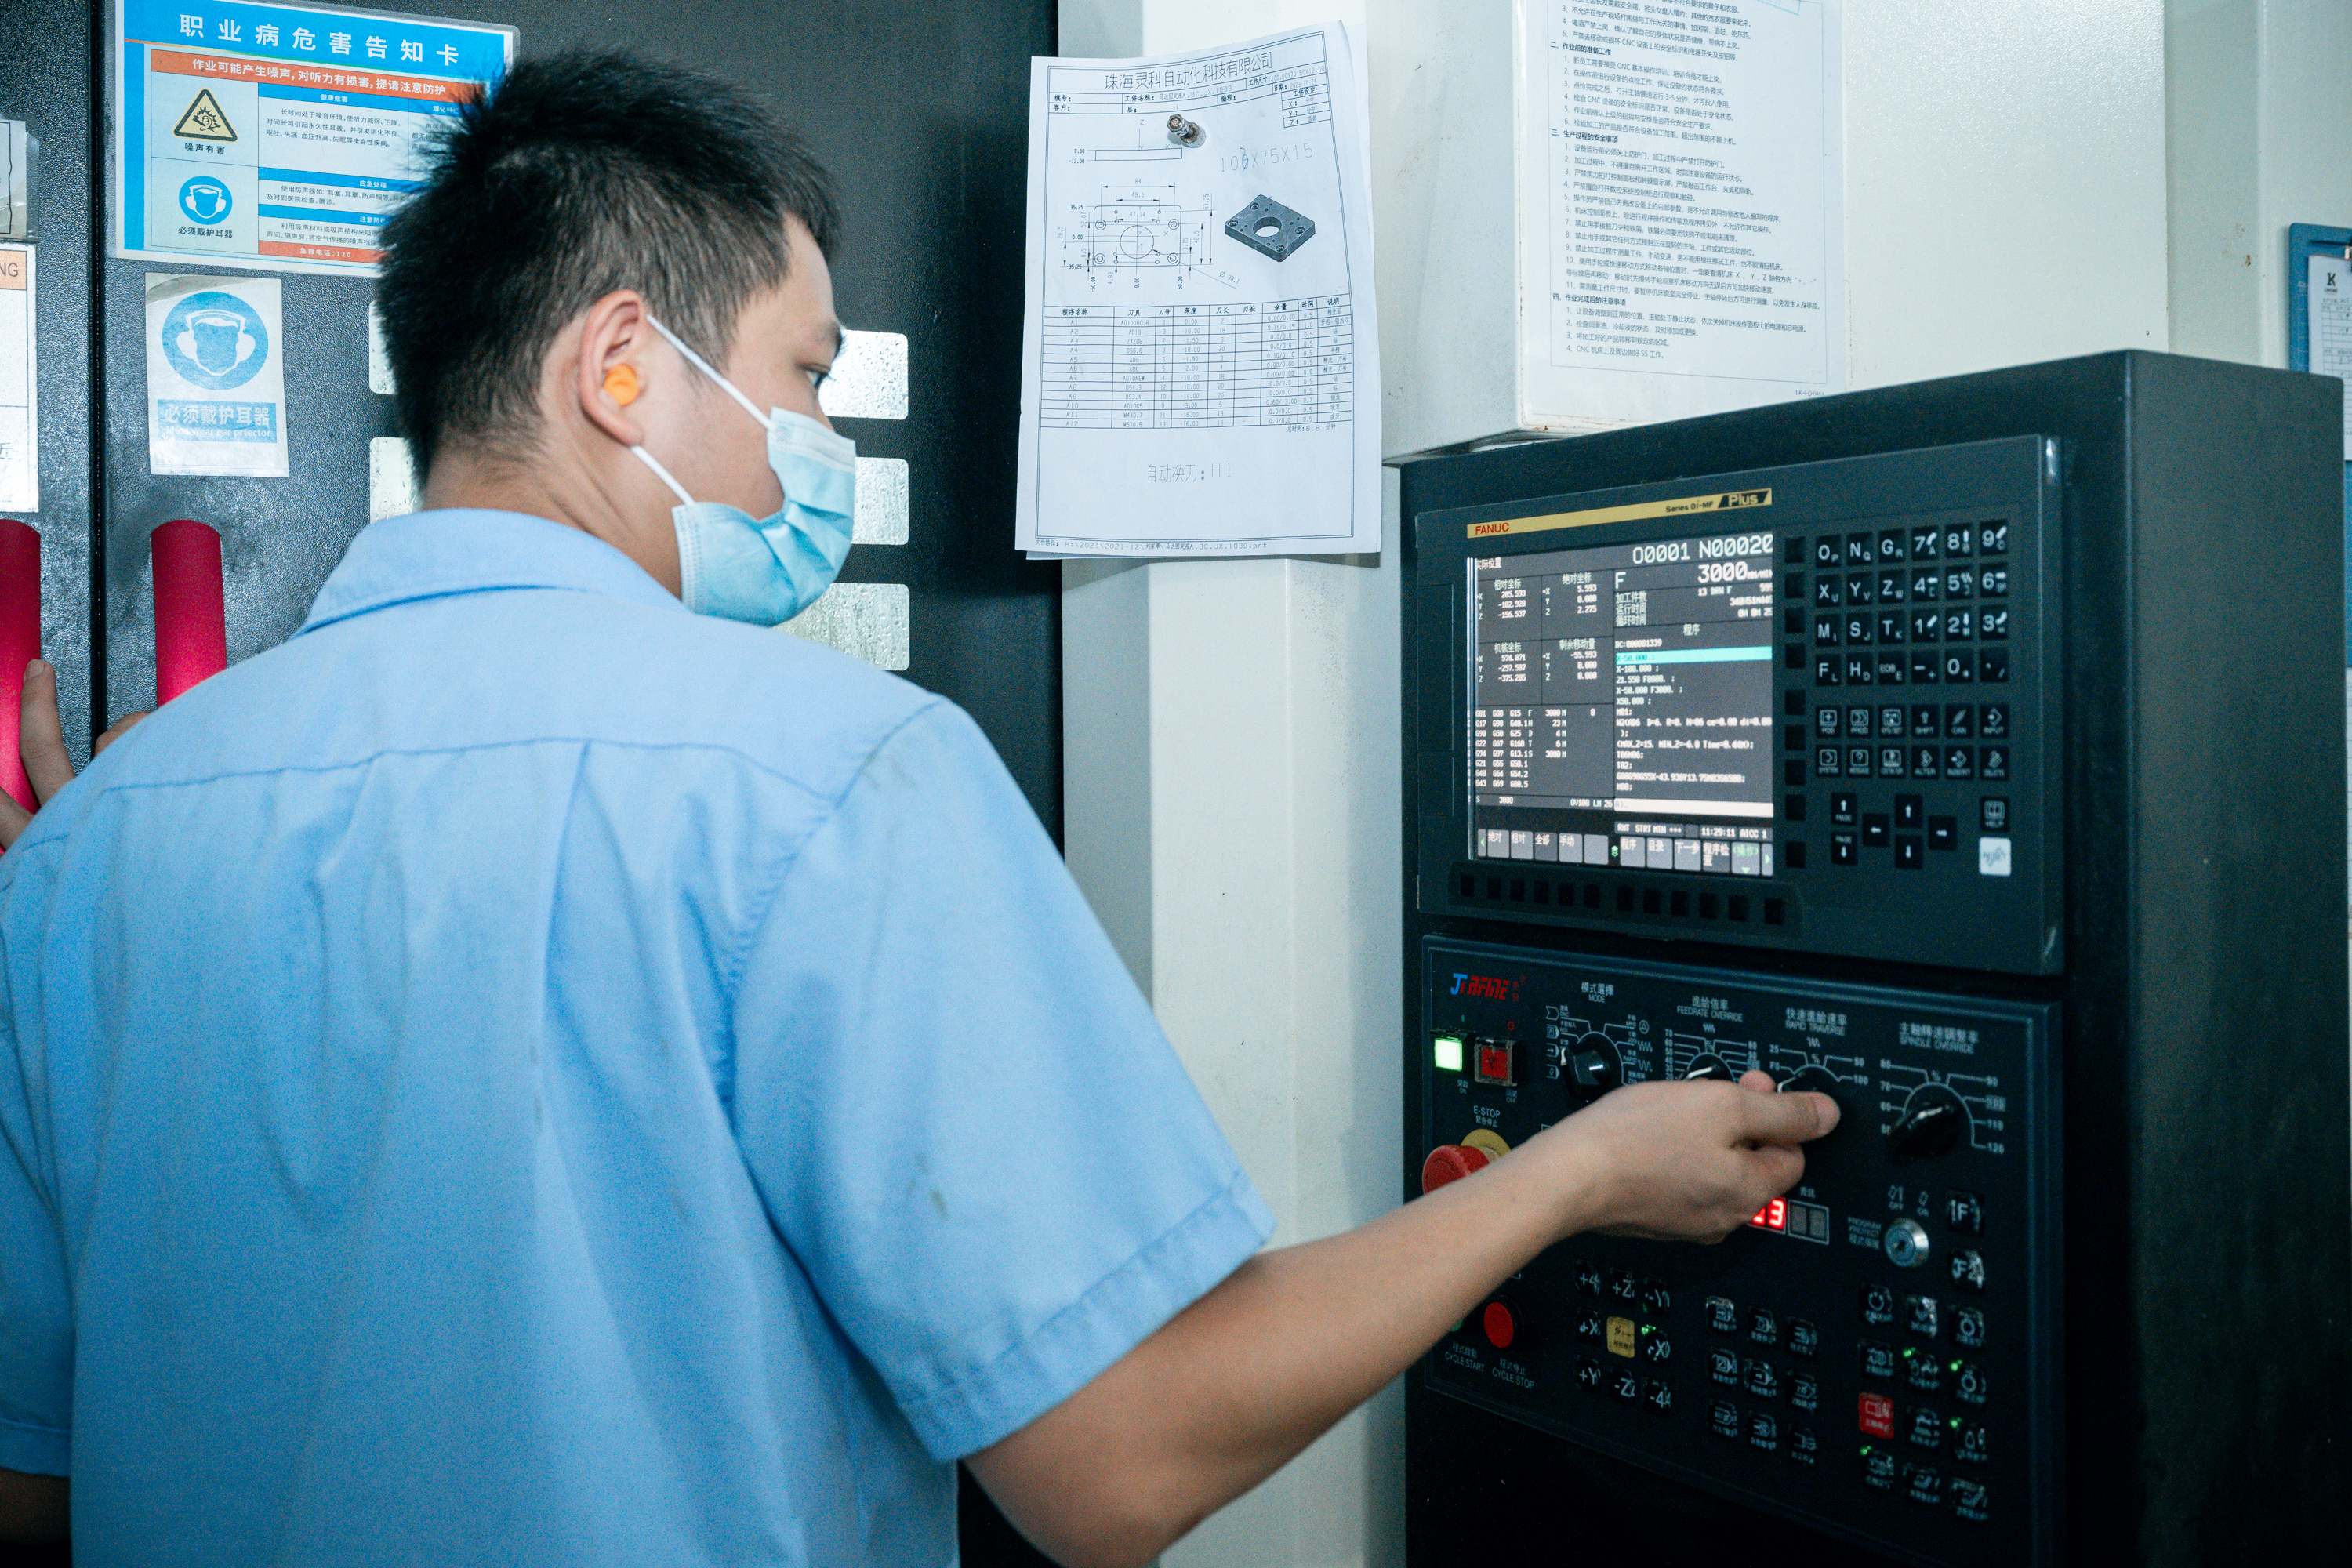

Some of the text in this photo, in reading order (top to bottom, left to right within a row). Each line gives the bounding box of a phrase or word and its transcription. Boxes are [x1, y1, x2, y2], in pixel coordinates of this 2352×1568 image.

[180, 14, 459, 66] 职业病危害告知卡
[1105, 51, 1272, 90] 珠海灵科自动化科技有限公司
[1290, 79, 1316, 89] 2023-10-24
[320, 93, 348, 103] 健康危害
[183, 143, 226, 155] 噪声有害
[359, 180, 387, 189] 应急处理
[178, 226, 234, 239] 必须戴护耳器
[165, 403, 270, 426] 必须戴护耳器
[1665, 503, 1688, 514] Series
[1728, 492, 1759, 506] Plus
[1475, 522, 1509, 535] FANUC
[1699, 534, 1773, 558] N00020
[1563, 572, 1592, 584] 绝对坐标
[1615, 572, 1626, 589] F
[1698, 561, 1748, 583] 3000
[1494, 579, 1521, 590] 相对坐标
[1577, 584, 1597, 593] 5.593
[1683, 624, 1700, 636] 程序
[1494, 642, 1521, 653] 机械坐标
[1559, 638, 1595, 650] 剩余移动量
[1487, 832, 1502, 843] 绝对
[1701, 827, 1736, 837] 11:29:11
[1512, 833, 1526, 844] 相对
[1535, 834, 1550, 846] 全部
[1559, 835, 1575, 847] 手动
[1621, 838, 1637, 851] 程序
[1649, 840, 1664, 851] 目录
[1675, 842, 1700, 855] 下一步
[1588, 994, 1606, 1004] MODE
[1473, 1106, 1500, 1117] E-STOP
[1445, 1352, 1485, 1372] CYCLE START
[1492, 1367, 1534, 1388] CYCLE STOP
